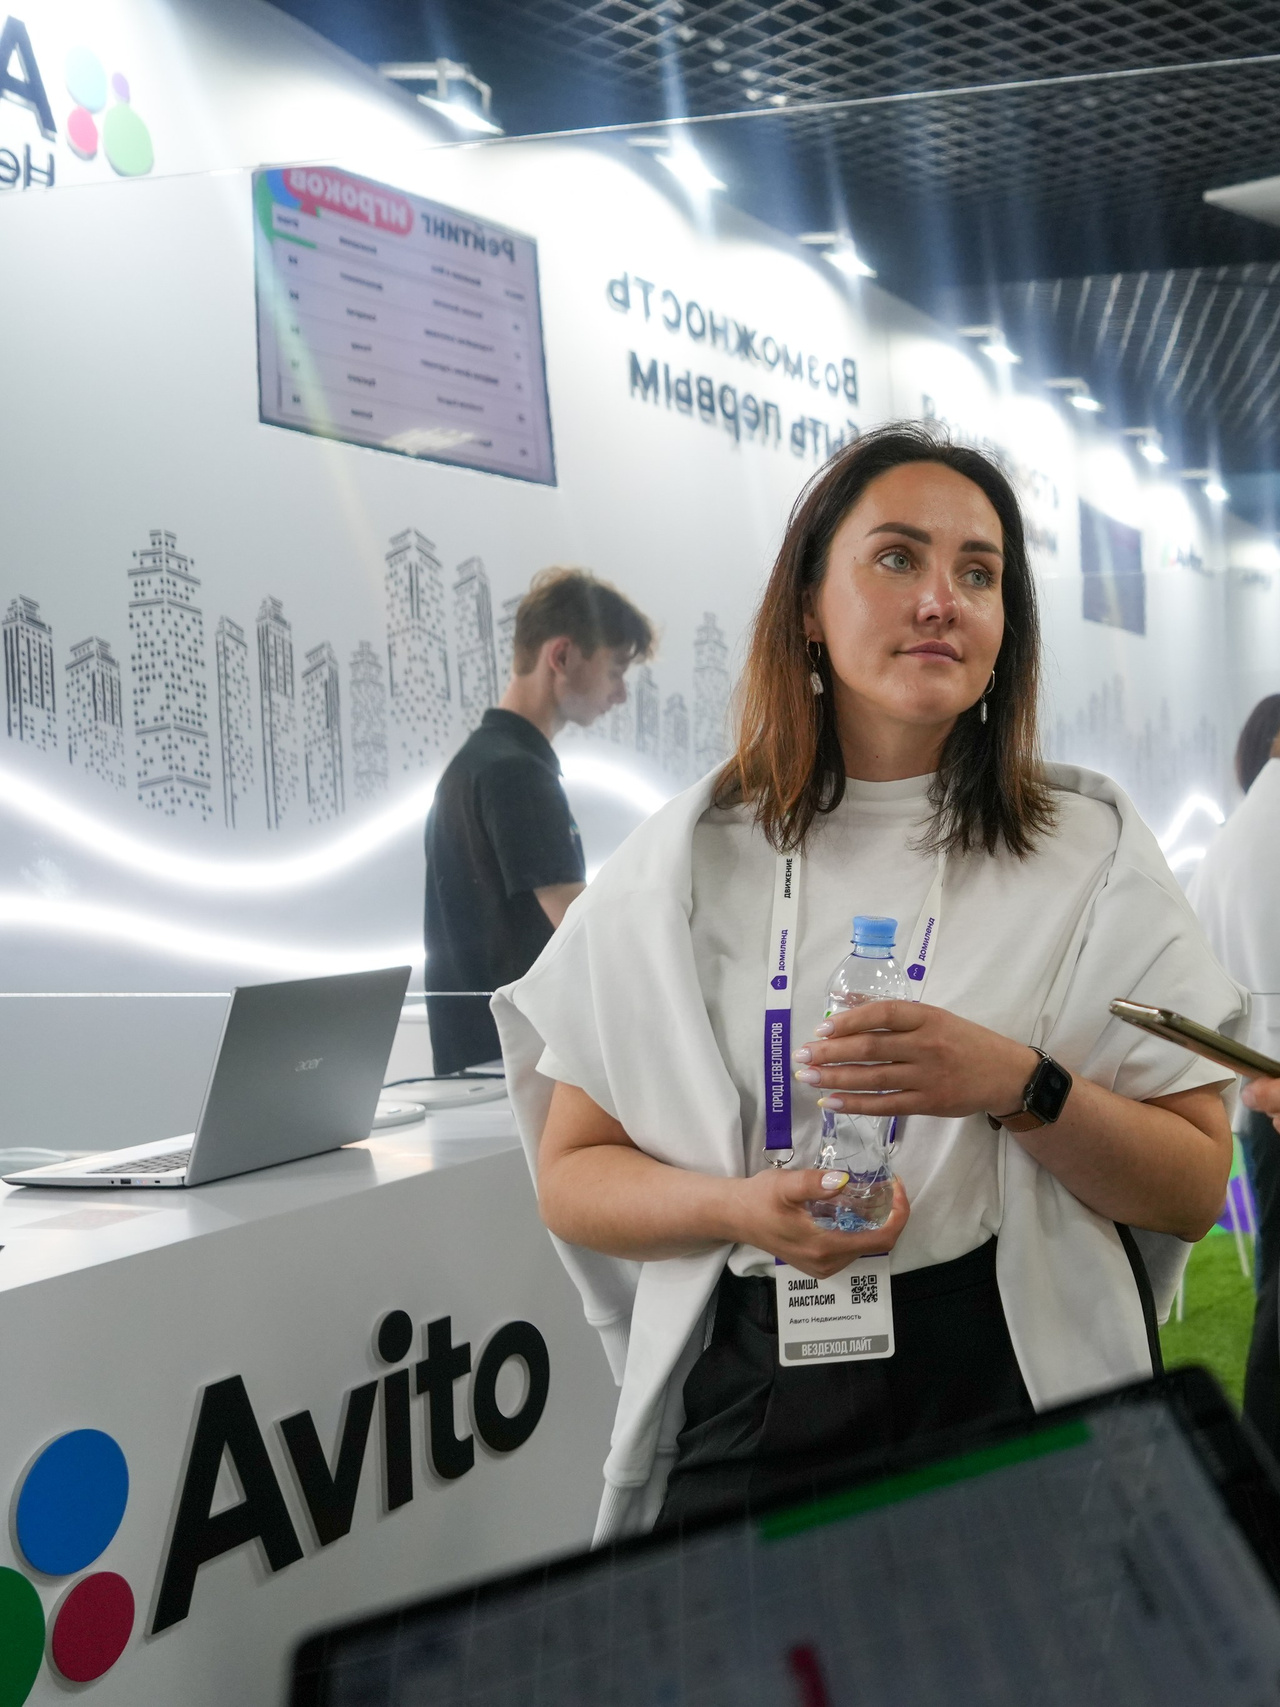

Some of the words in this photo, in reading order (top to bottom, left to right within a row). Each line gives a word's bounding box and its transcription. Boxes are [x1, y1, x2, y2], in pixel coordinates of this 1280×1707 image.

[784, 858, 793, 898] ДВИЖЕНИЕ
[771, 1022, 784, 1083] ДЕВЕЛОПЕРОВ
[772, 1084, 784, 1112] ГОРОД
[788, 1278, 818, 1291] ЗАМША
[788, 1293, 835, 1307] АНАСТАСИЯ
[811, 1314, 861, 1323] Недвижимость
[801, 1340, 848, 1356] ВЕЗДЕХОД
[849, 1336, 872, 1352] ЛАЙТ
[149, 1309, 550, 1635] Avito
